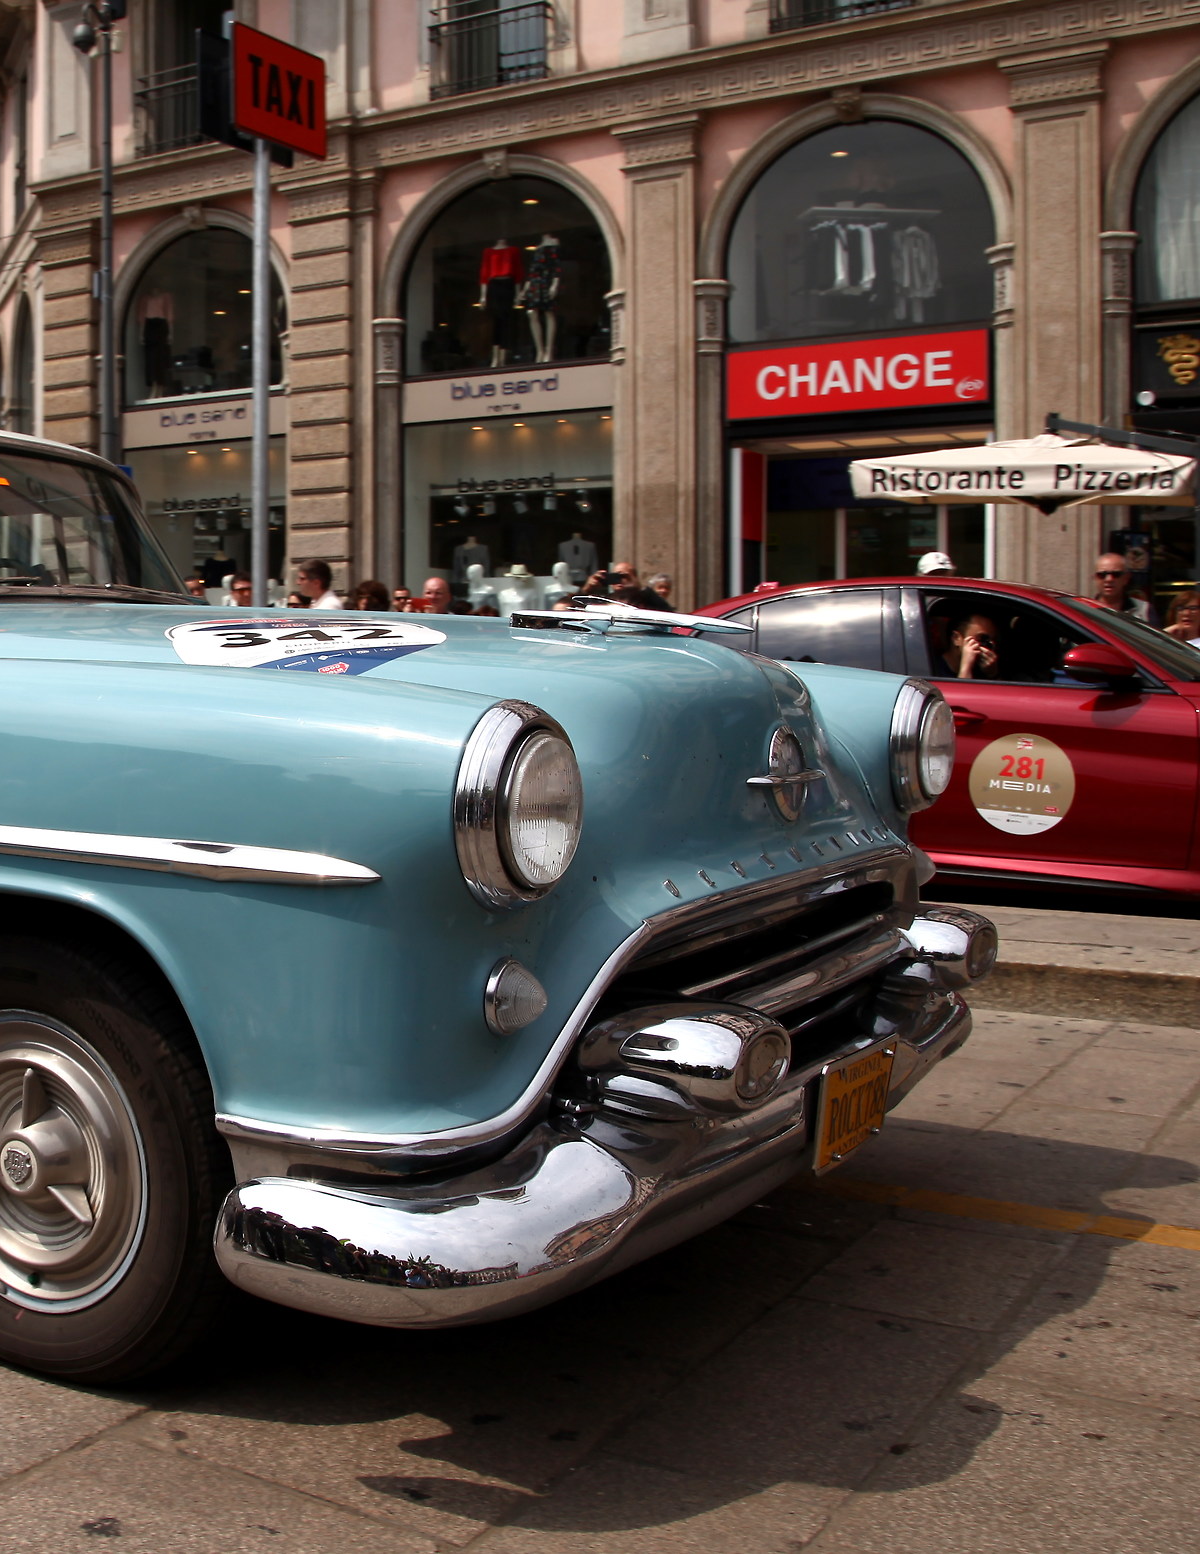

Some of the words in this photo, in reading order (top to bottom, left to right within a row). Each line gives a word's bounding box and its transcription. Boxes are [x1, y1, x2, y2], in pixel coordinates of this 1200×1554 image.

[247, 53, 315, 130] TAXI
[451, 382, 496, 400] blue
[502, 373, 559, 395] sand
[756, 350, 954, 400] CHANGE
[160, 410, 196, 428] blue
[201, 403, 247, 424] sand
[458, 478, 498, 493] blue
[504, 472, 555, 489] sand
[871, 466, 1026, 493] Ristorante
[1053, 463, 1175, 491] Pizzeria
[163, 498, 195, 511] blue
[199, 493, 240, 509] sand
[214, 628, 404, 648] 342
[998, 755, 1046, 780] 281
[989, 779, 1051, 794] MEDIA
[839, 1056, 883, 1084] VIRGINIA
